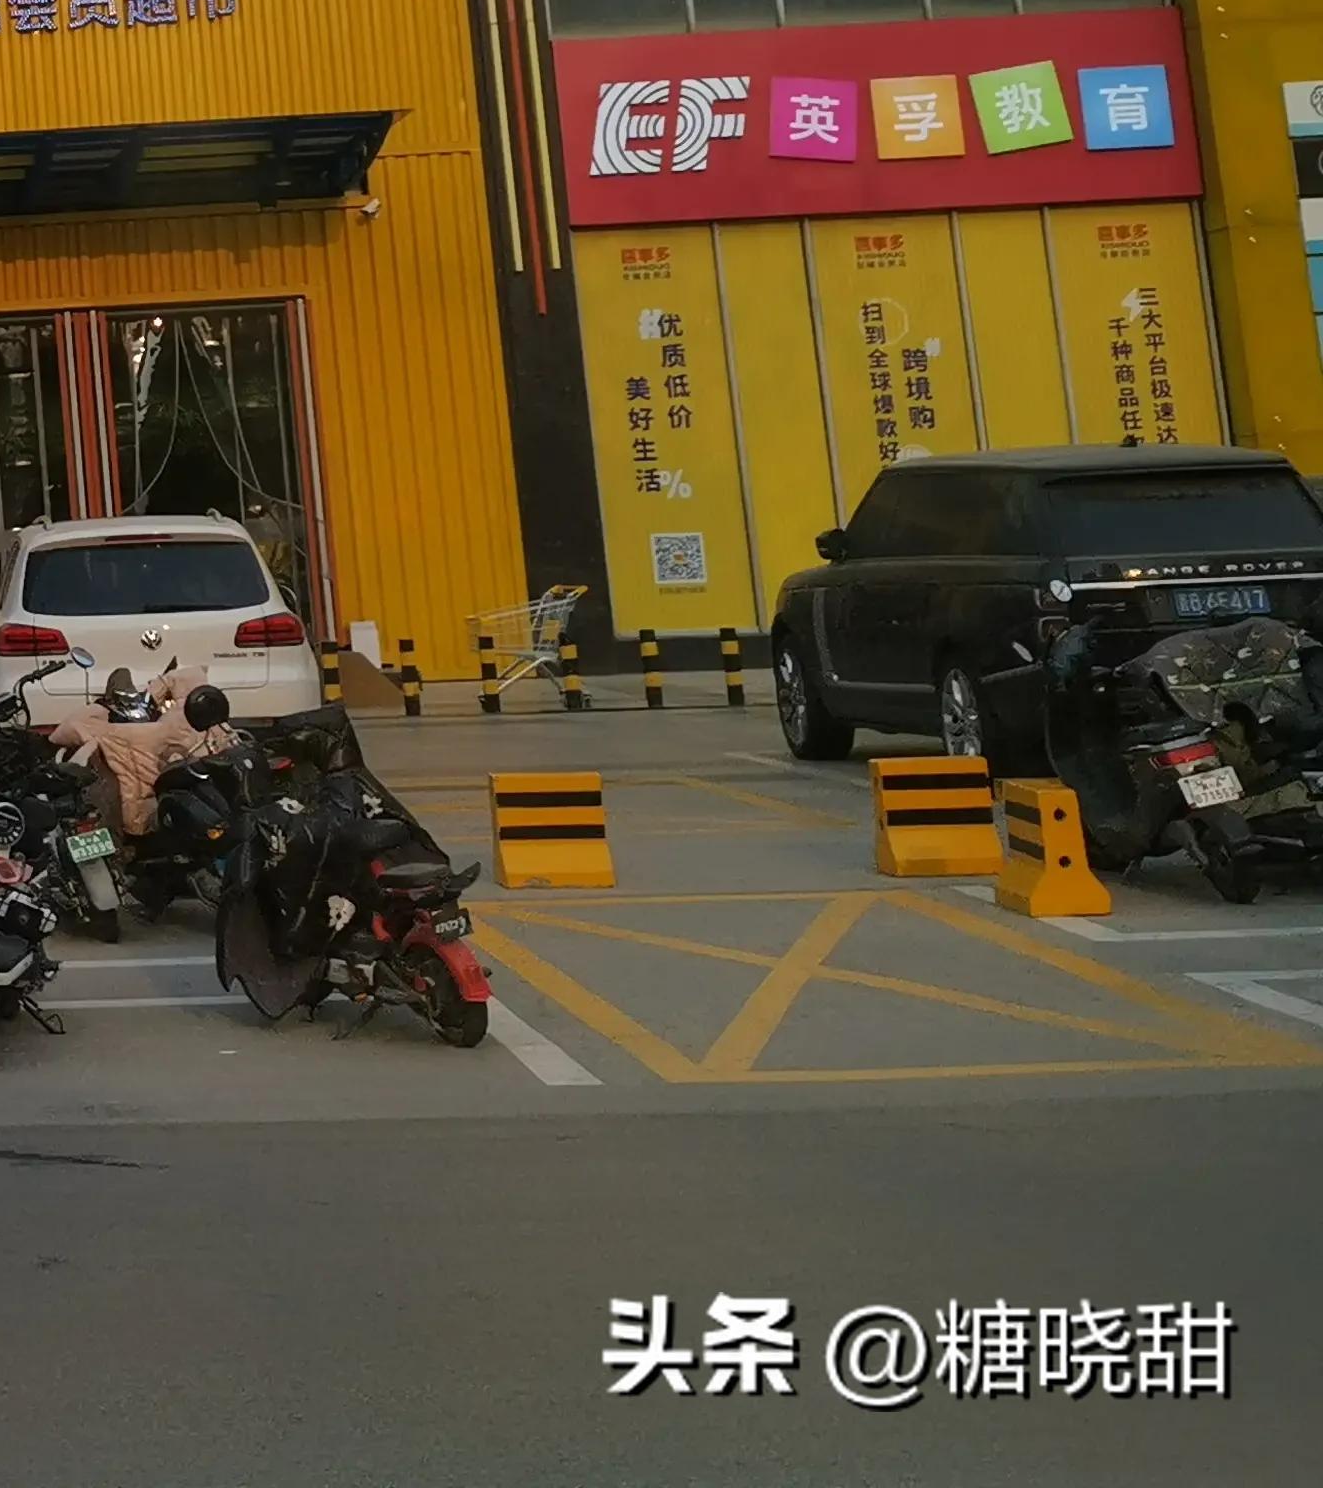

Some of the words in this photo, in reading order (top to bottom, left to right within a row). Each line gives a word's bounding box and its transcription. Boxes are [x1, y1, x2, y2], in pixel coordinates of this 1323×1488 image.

[590, 75, 750, 177] EF
[788, 82, 1150, 145] 英孚教育
[657, 313, 693, 429] 优质低价
[861, 301, 900, 469] 扫到全球爆款好
[901, 348, 936, 430] 跨境购
[1139, 287, 1179, 444] 三大平台极速达
[625, 377, 662, 493] 美好生活
